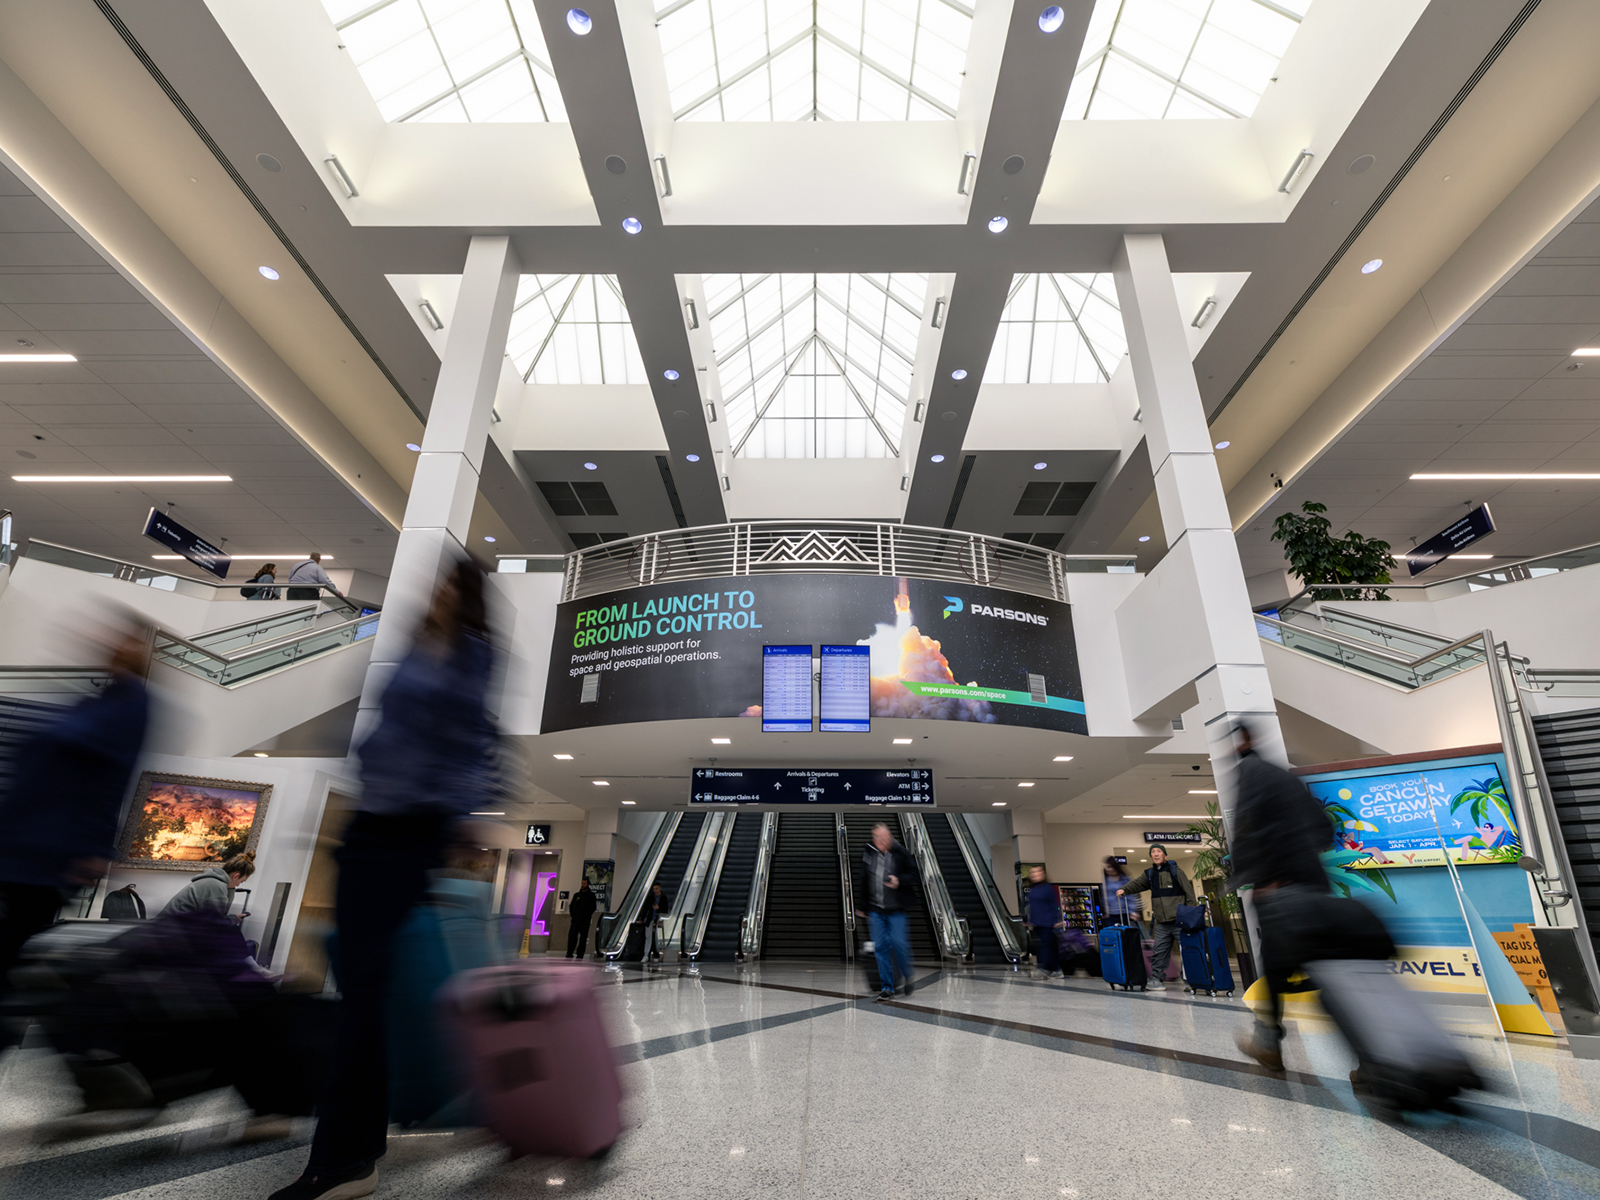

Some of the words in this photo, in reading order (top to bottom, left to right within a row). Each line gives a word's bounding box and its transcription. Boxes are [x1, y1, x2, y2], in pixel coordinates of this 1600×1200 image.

[576, 604, 628, 629] FROM
[632, 592, 719, 619] LAUNCH
[724, 591, 755, 609] TO
[971, 604, 1047, 626] PARSONS
[574, 620, 651, 648] GROUND
[656, 611, 762, 635] CONTROL
[571, 649, 609, 664] Providing
[611, 644, 644, 658] holistic
[646, 640, 684, 654] support
[687, 638, 701, 648] for
[569, 666, 594, 677] space
[596, 660, 611, 672] and
[614, 654, 662, 672] geospatial
[665, 651, 721, 666] operations.
[920, 685, 1006, 700] www.parsons.com/space
[1360, 782, 1445, 806] CANCUN
[1369, 782, 1398, 792] BOOK
[1401, 778, 1428, 787] YOUR
[1360, 794, 1452, 818] GETAWAY
[1500, 942, 1518, 950] TAG
[1519, 942, 1532, 950] US
[1384, 961, 1466, 976] RAVEL
[1505, 955, 1531, 964] OCIAL
